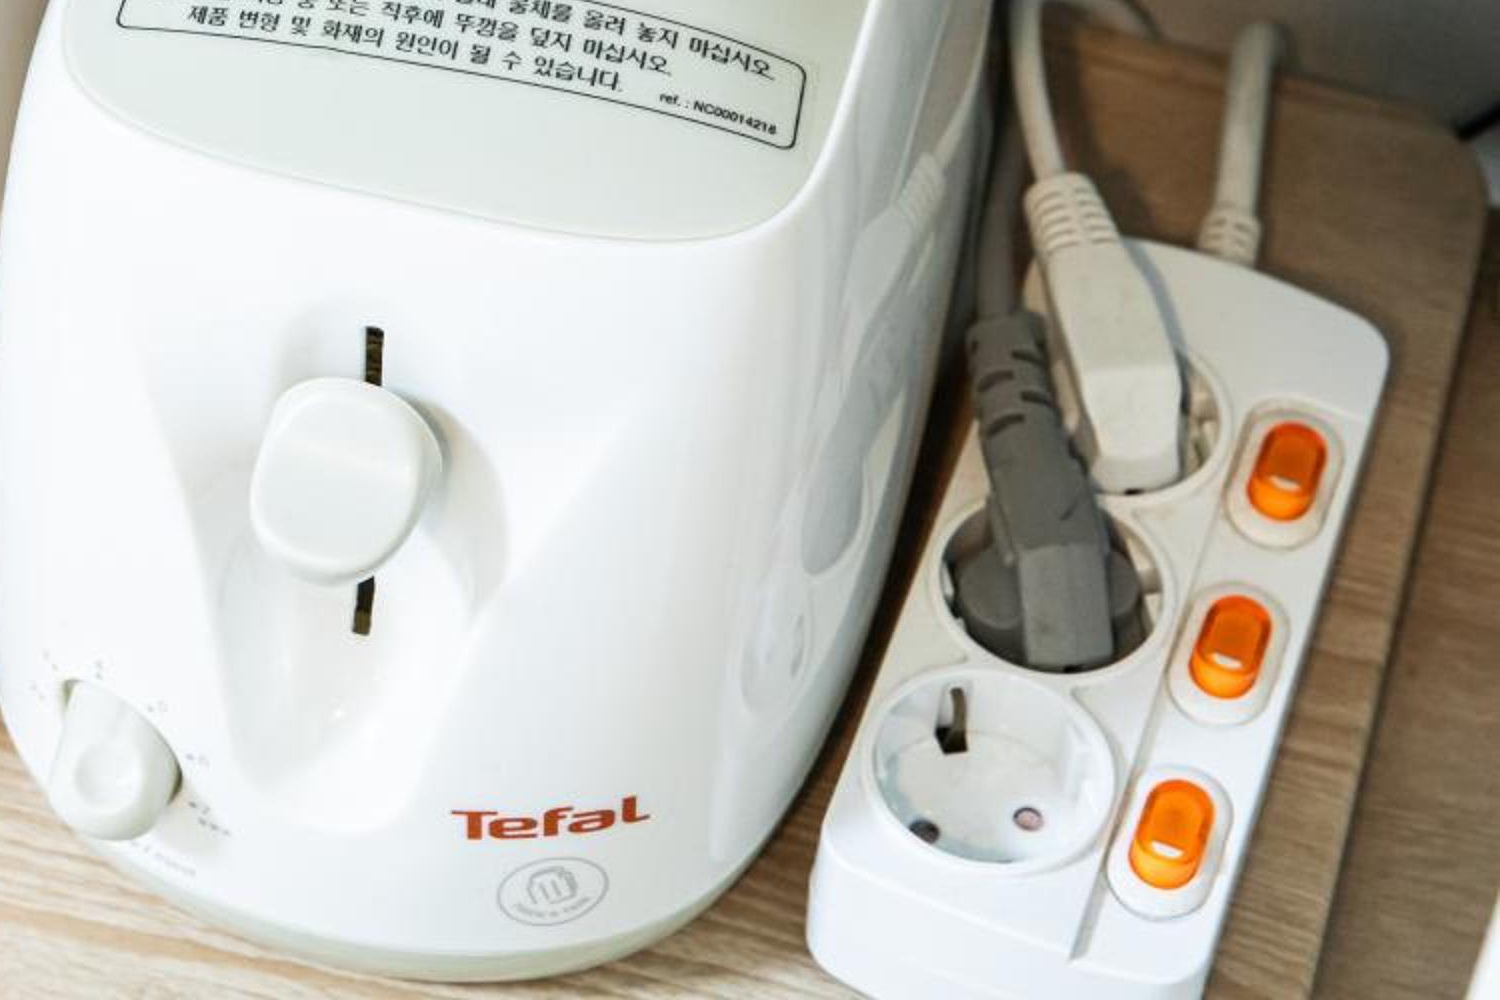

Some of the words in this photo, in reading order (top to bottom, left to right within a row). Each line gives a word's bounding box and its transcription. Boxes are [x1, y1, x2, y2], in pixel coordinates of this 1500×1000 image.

[186, 4, 230, 27] 제품
[238, 9, 281, 32] 변형
[290, 14, 312, 37] 및
[321, 18, 385, 49] 화재의
[395, 31, 460, 61] 원인이
[469, 43, 492, 65] 될
[501, 50, 523, 71] 수
[381, 1, 446, 30] 직후에
[455, 13, 520, 43] 뚜껑을
[530, 27, 573, 53] 덮지
[583, 9, 626, 36] 올려
[637, 22, 679, 50] 놓지
[451, 795, 650, 841] Tefal
